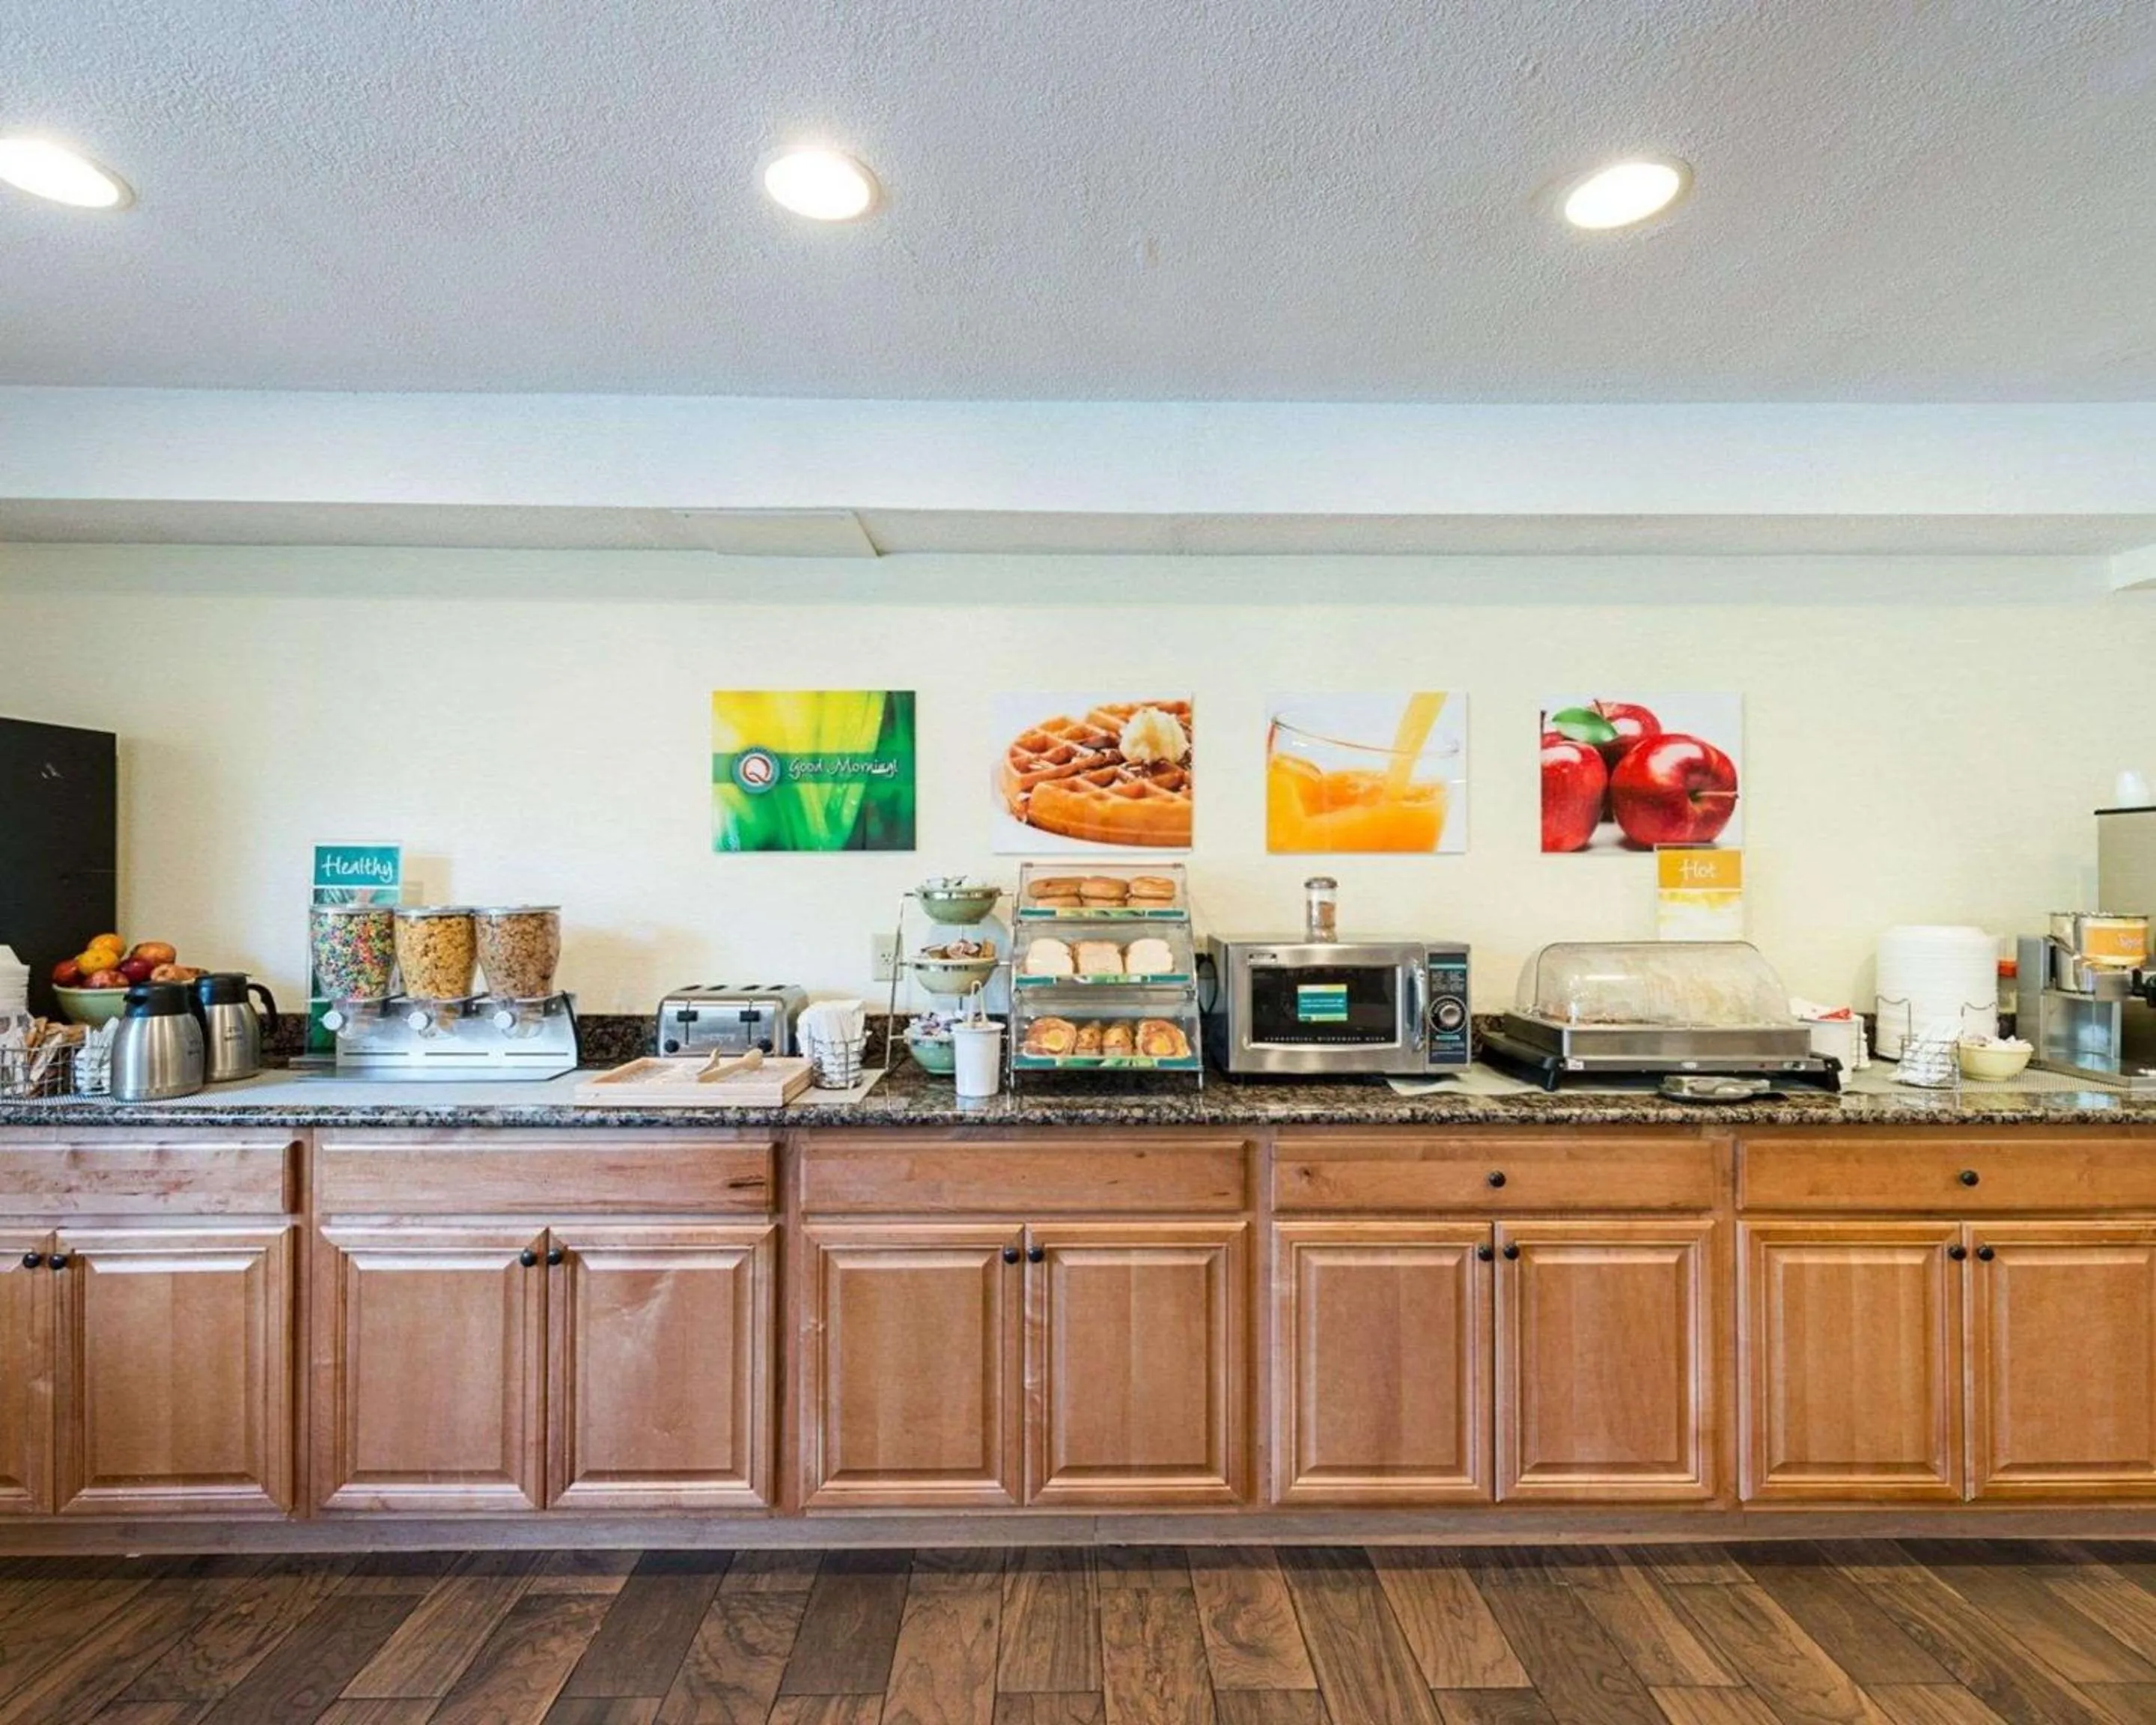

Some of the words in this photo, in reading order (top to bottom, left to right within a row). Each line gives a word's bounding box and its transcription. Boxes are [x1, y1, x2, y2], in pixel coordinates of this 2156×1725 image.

[743, 755, 770, 784] Q
[789, 756, 823, 779] Good
[827, 756, 898, 779] Morning!
[321, 854, 393, 883] Healthy
[1678, 858, 1717, 881] Hot
